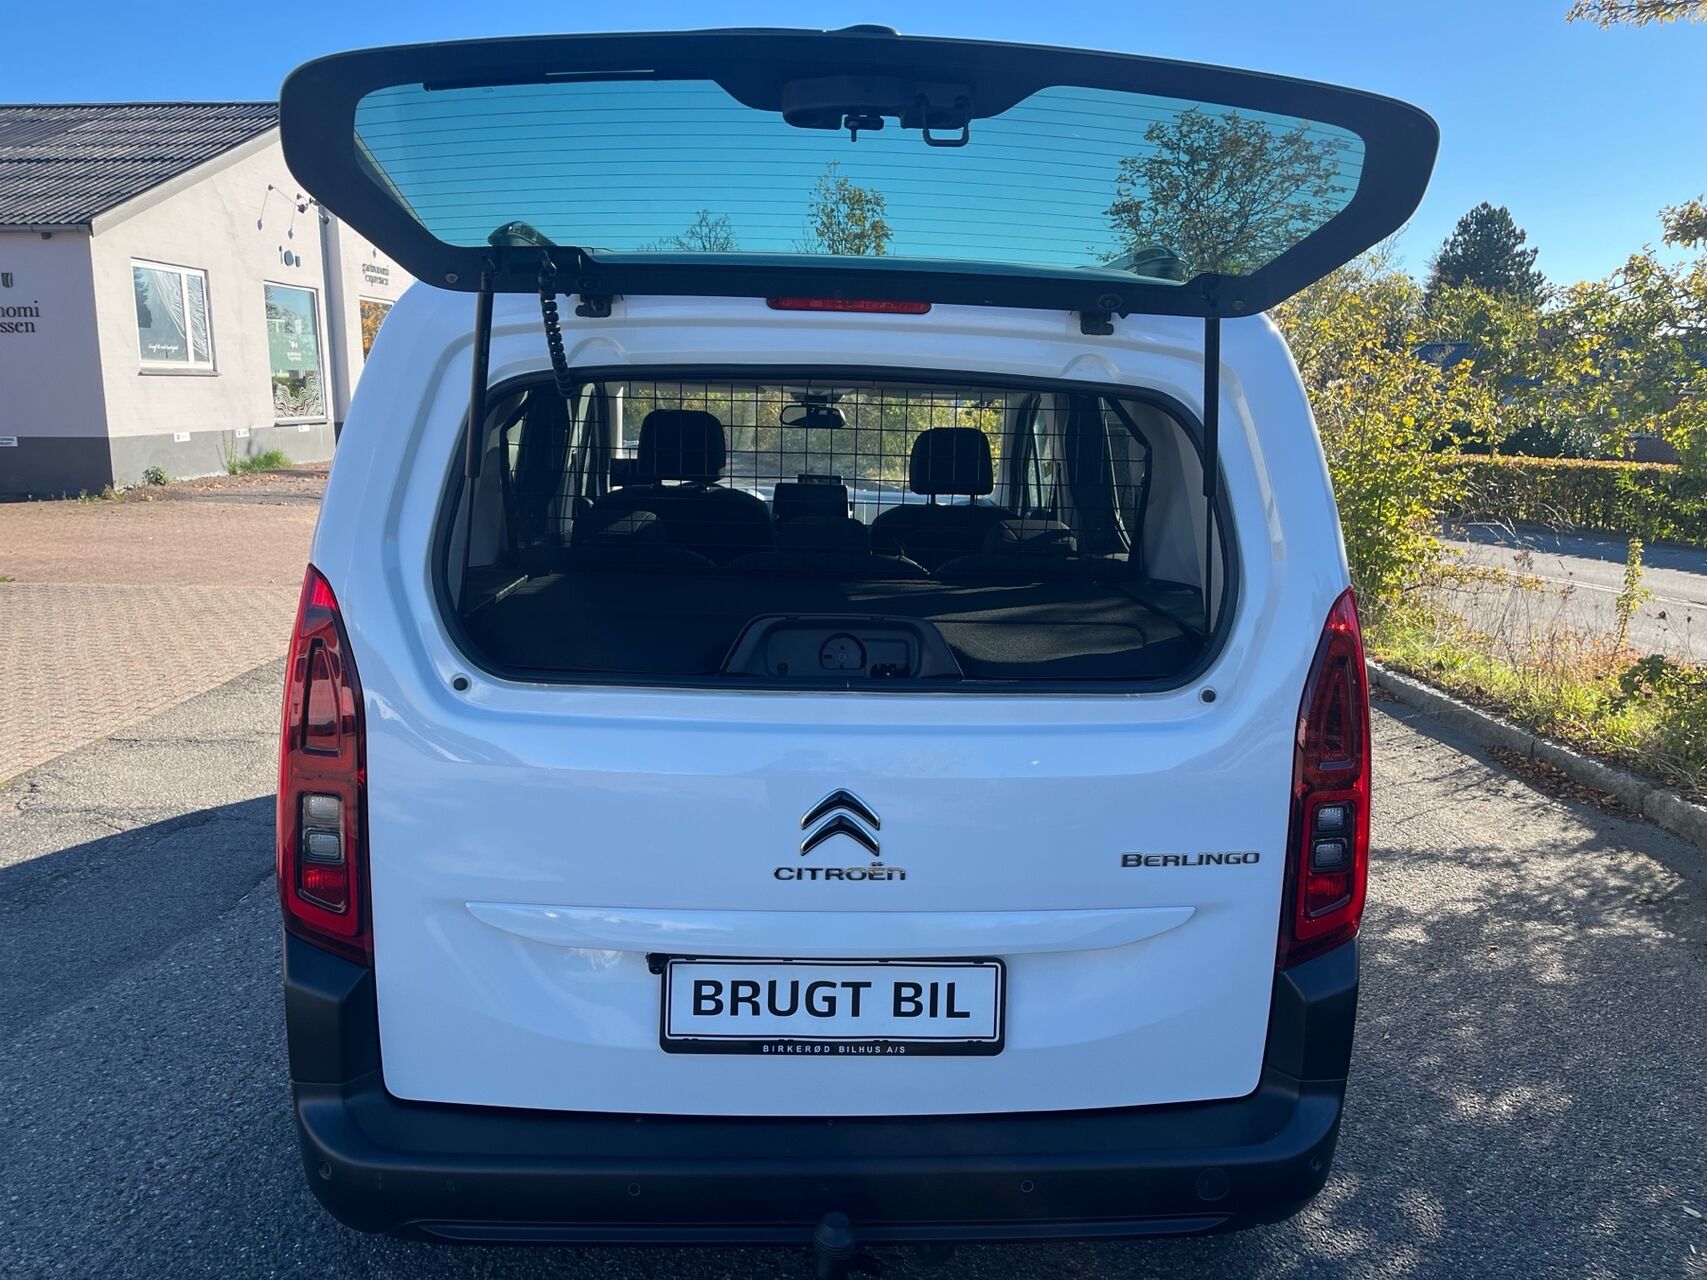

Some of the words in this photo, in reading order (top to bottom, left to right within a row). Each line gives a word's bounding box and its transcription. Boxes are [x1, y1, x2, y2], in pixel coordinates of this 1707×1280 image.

[1121, 852, 1260, 868] BERLINGO
[773, 861, 906, 881] CITROËN
[692, 979, 872, 1018] BRUGT
[893, 981, 971, 1019] BIL
[762, 1044, 831, 1054] BIRKERØD
[838, 1045, 881, 1054] BILHUS
[886, 1045, 906, 1054] A/S
